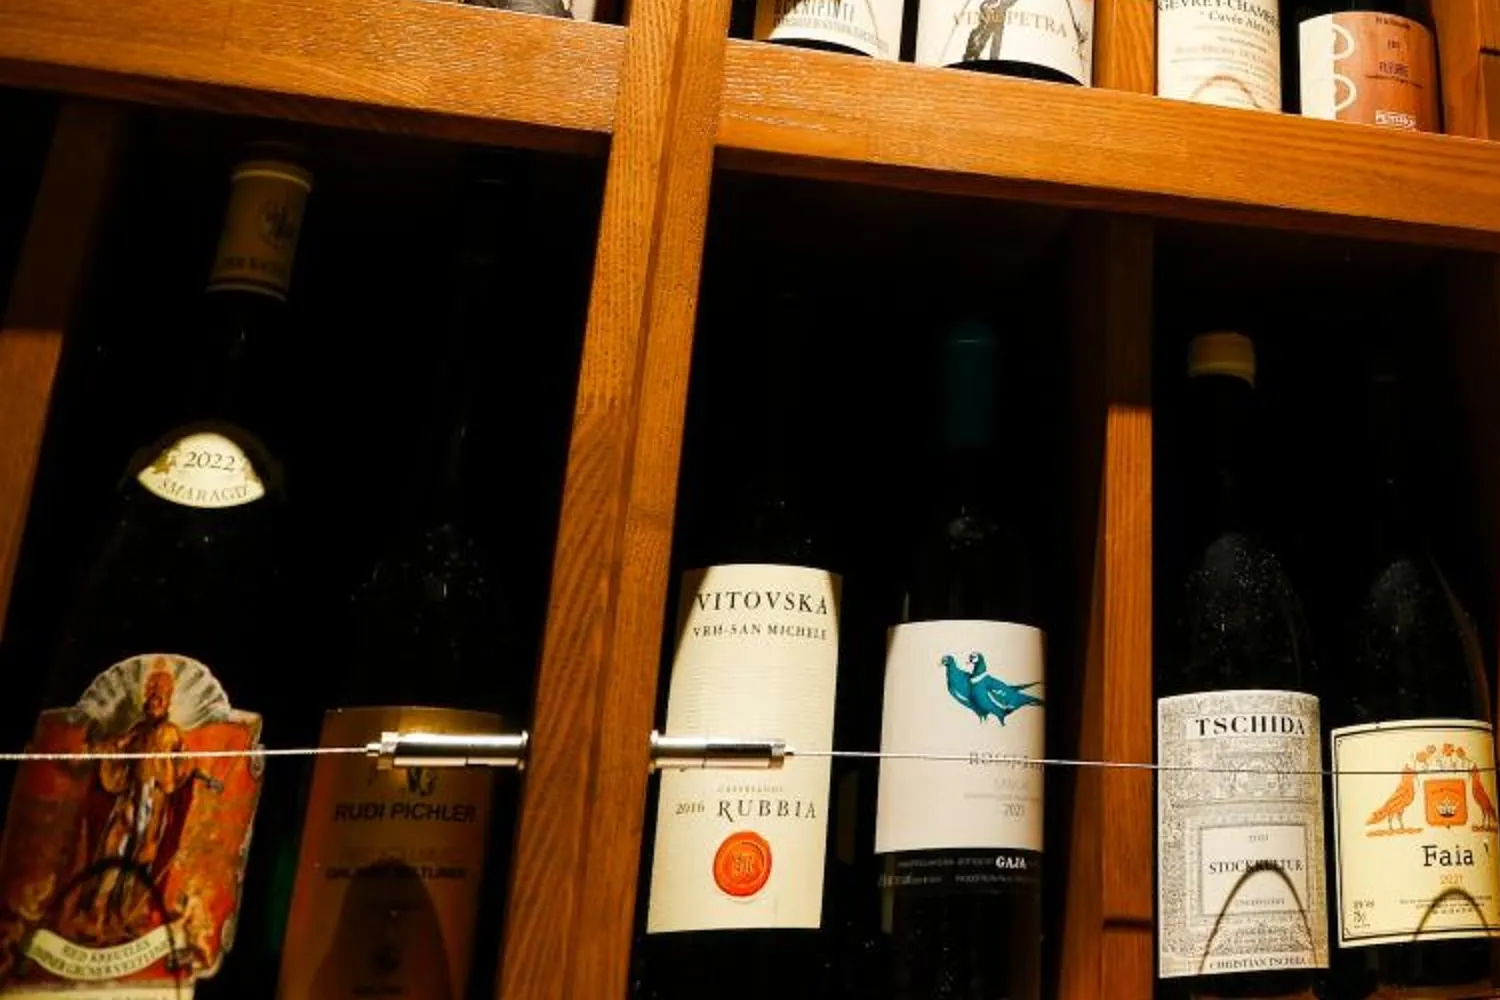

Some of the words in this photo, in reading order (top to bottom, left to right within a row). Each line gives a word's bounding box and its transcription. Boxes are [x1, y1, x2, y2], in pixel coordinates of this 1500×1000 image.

[183, 450, 236, 472] 2022
[157, 478, 249, 502] SMARAGD
[696, 589, 828, 615] VITOVSKA
[1194, 715, 1306, 737] TSCHIDA
[335, 802, 385, 823] RUDI
[390, 803, 477, 825] PICHLER
[717, 799, 817, 823] RUBBIA
[995, 855, 1027, 871] GAJA
[1420, 844, 1475, 867] Faia
